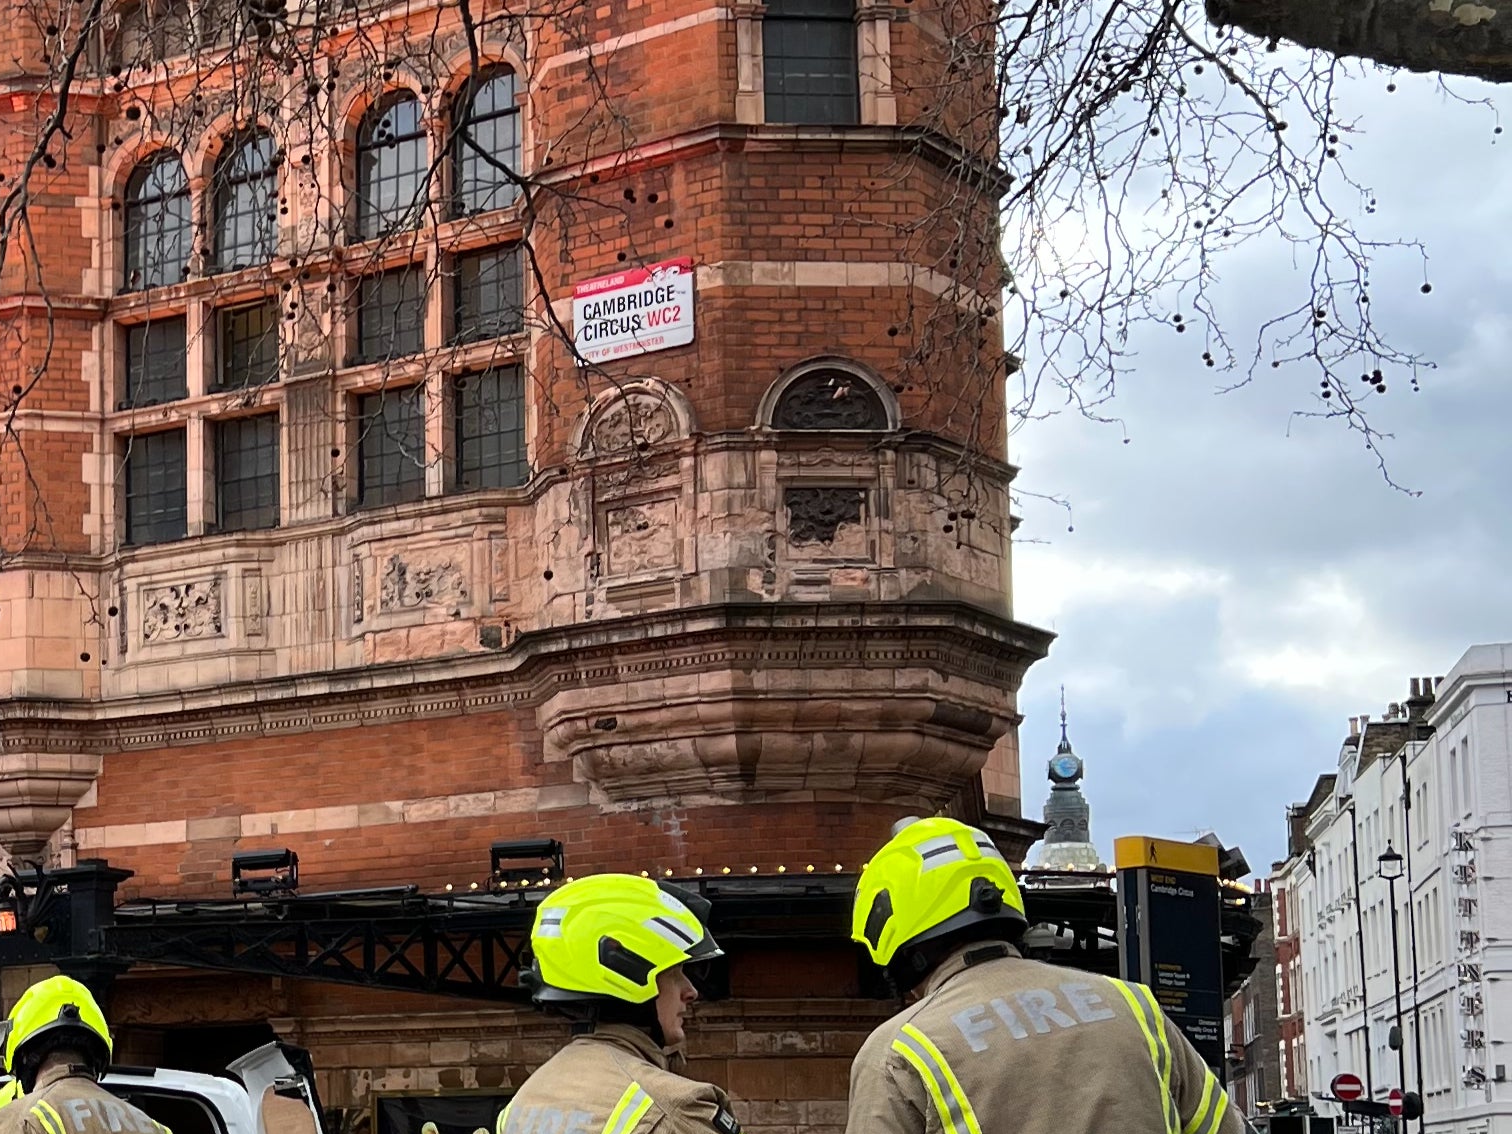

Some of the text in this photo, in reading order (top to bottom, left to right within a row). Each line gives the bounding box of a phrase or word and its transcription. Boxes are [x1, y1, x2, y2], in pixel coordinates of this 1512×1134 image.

[583, 284, 676, 321] CAMBRIDGE
[583, 305, 681, 342] CIRCUS WC2
[951, 982, 1116, 1053] FIRE
[64, 1099, 154, 1134] FIRE
